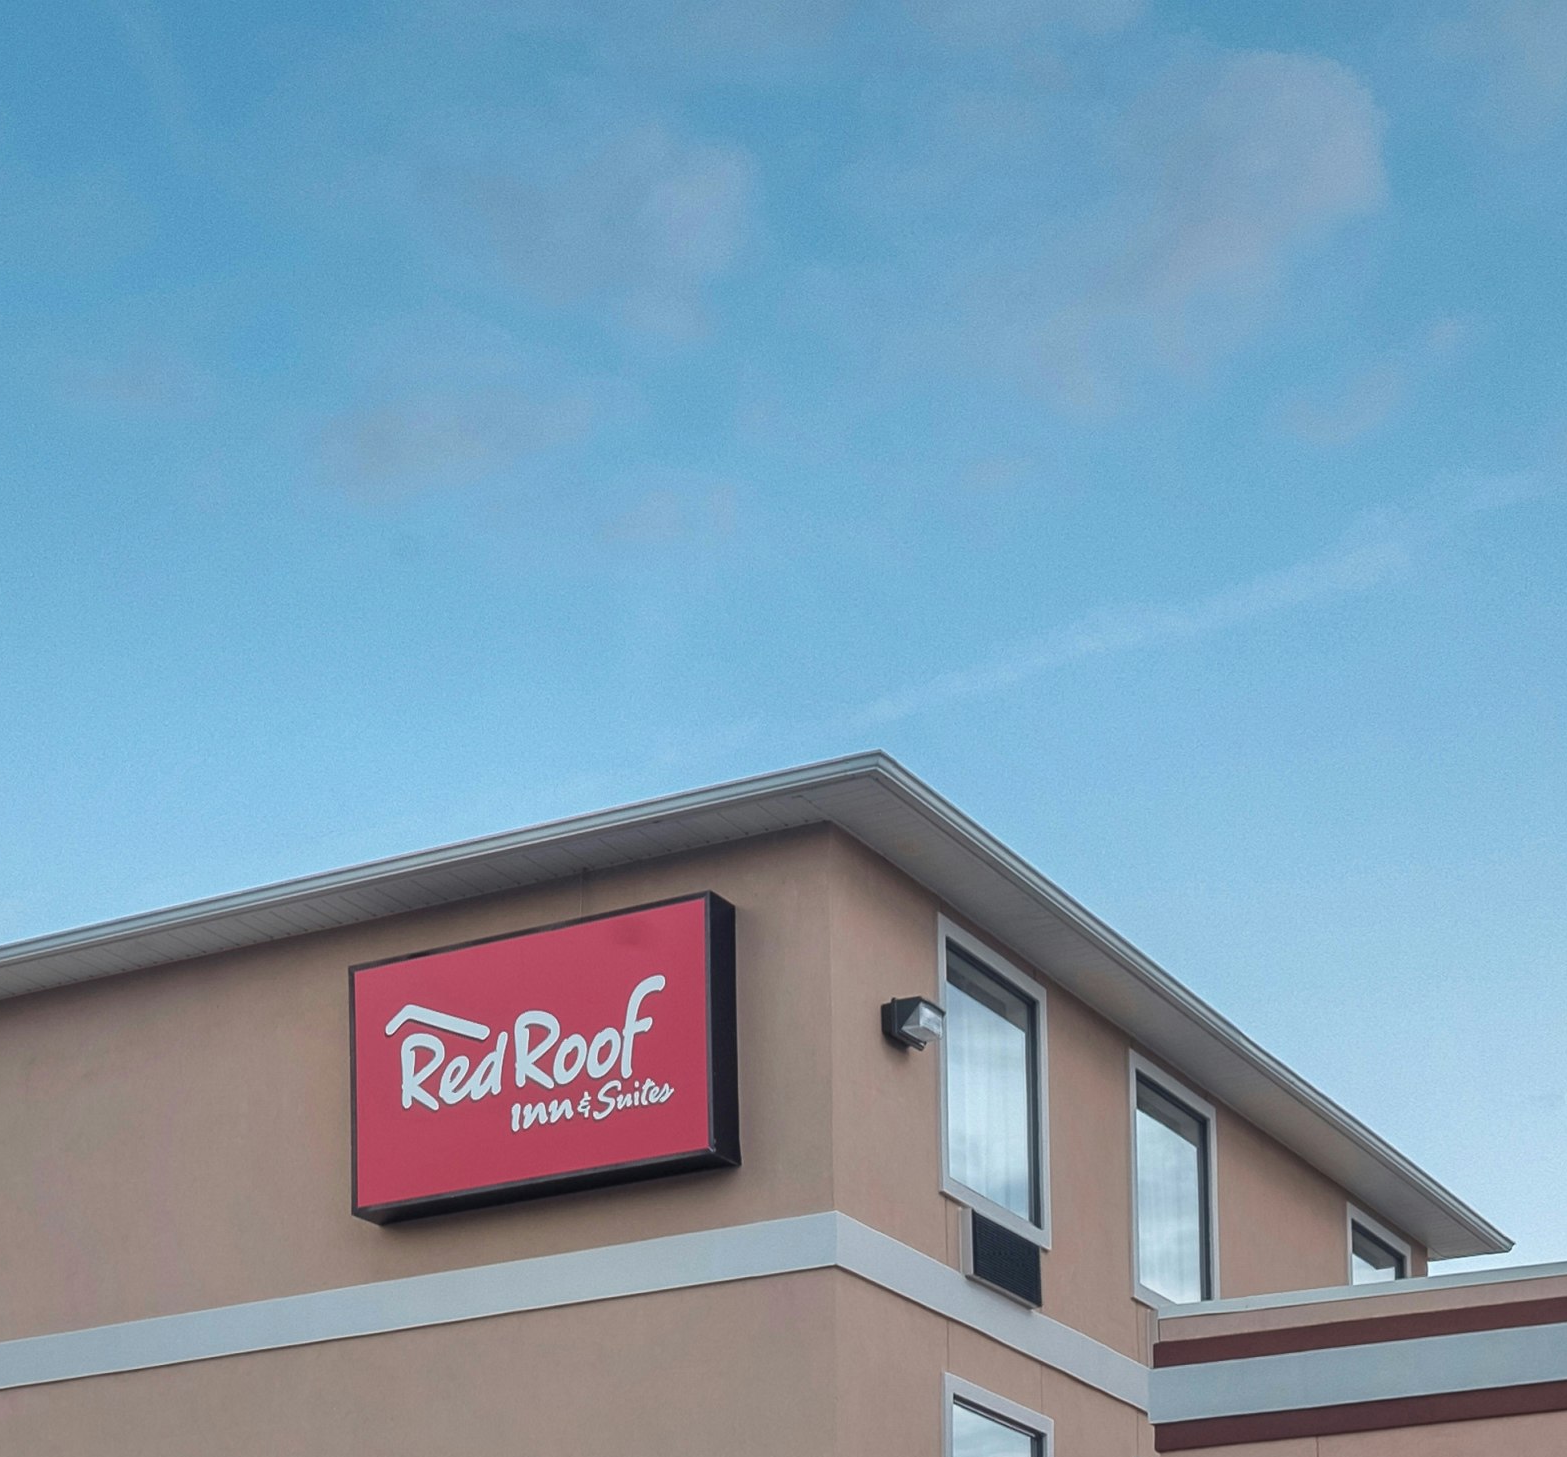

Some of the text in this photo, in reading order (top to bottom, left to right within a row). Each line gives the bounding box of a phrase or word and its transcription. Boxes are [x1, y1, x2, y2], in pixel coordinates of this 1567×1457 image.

[401, 974, 666, 1111] Red Roof
[511, 1079, 674, 1132] Inn & Suites
